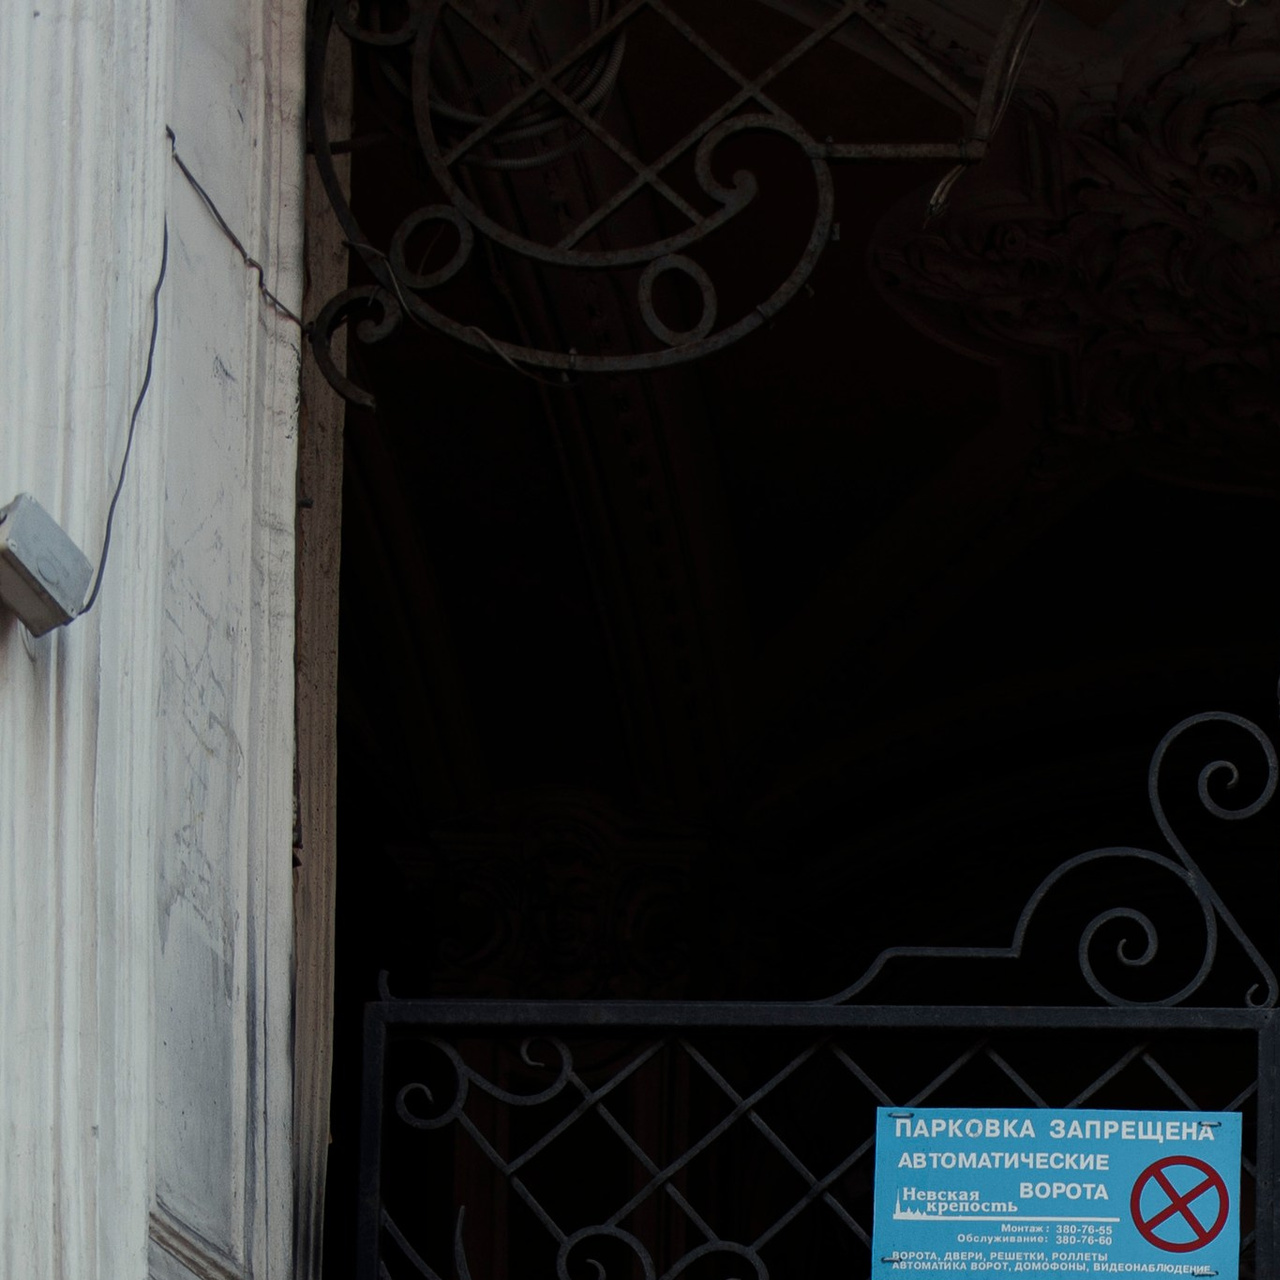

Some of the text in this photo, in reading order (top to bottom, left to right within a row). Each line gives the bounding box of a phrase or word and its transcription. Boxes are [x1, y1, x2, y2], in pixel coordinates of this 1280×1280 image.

[895, 1118, 1215, 1144] ПАРКОВКА ЗАПРЕЩЕНА
[898, 1151, 1110, 1171] АВТОМАТИЧЕСКИЕ
[902, 1186, 980, 1202] Невская
[1019, 1182, 1109, 1200] ВОРОТА
[926, 1200, 1018, 1216] крепость
[957, 1233, 1049, 1245] Обслуживание:
[943, 1251, 986, 1262] ДВЕРИ,
[990, 1251, 1049, 1262] РЕШЕТКИ,
[1051, 1251, 1108, 1262] РОЛЛЕТЫ
[892, 1260, 1211, 1275] АВТОМАТИКА ВОРОТ, ДОМОФОНЫ, ВИДЕОНАБЛЮДЕНИЕ
